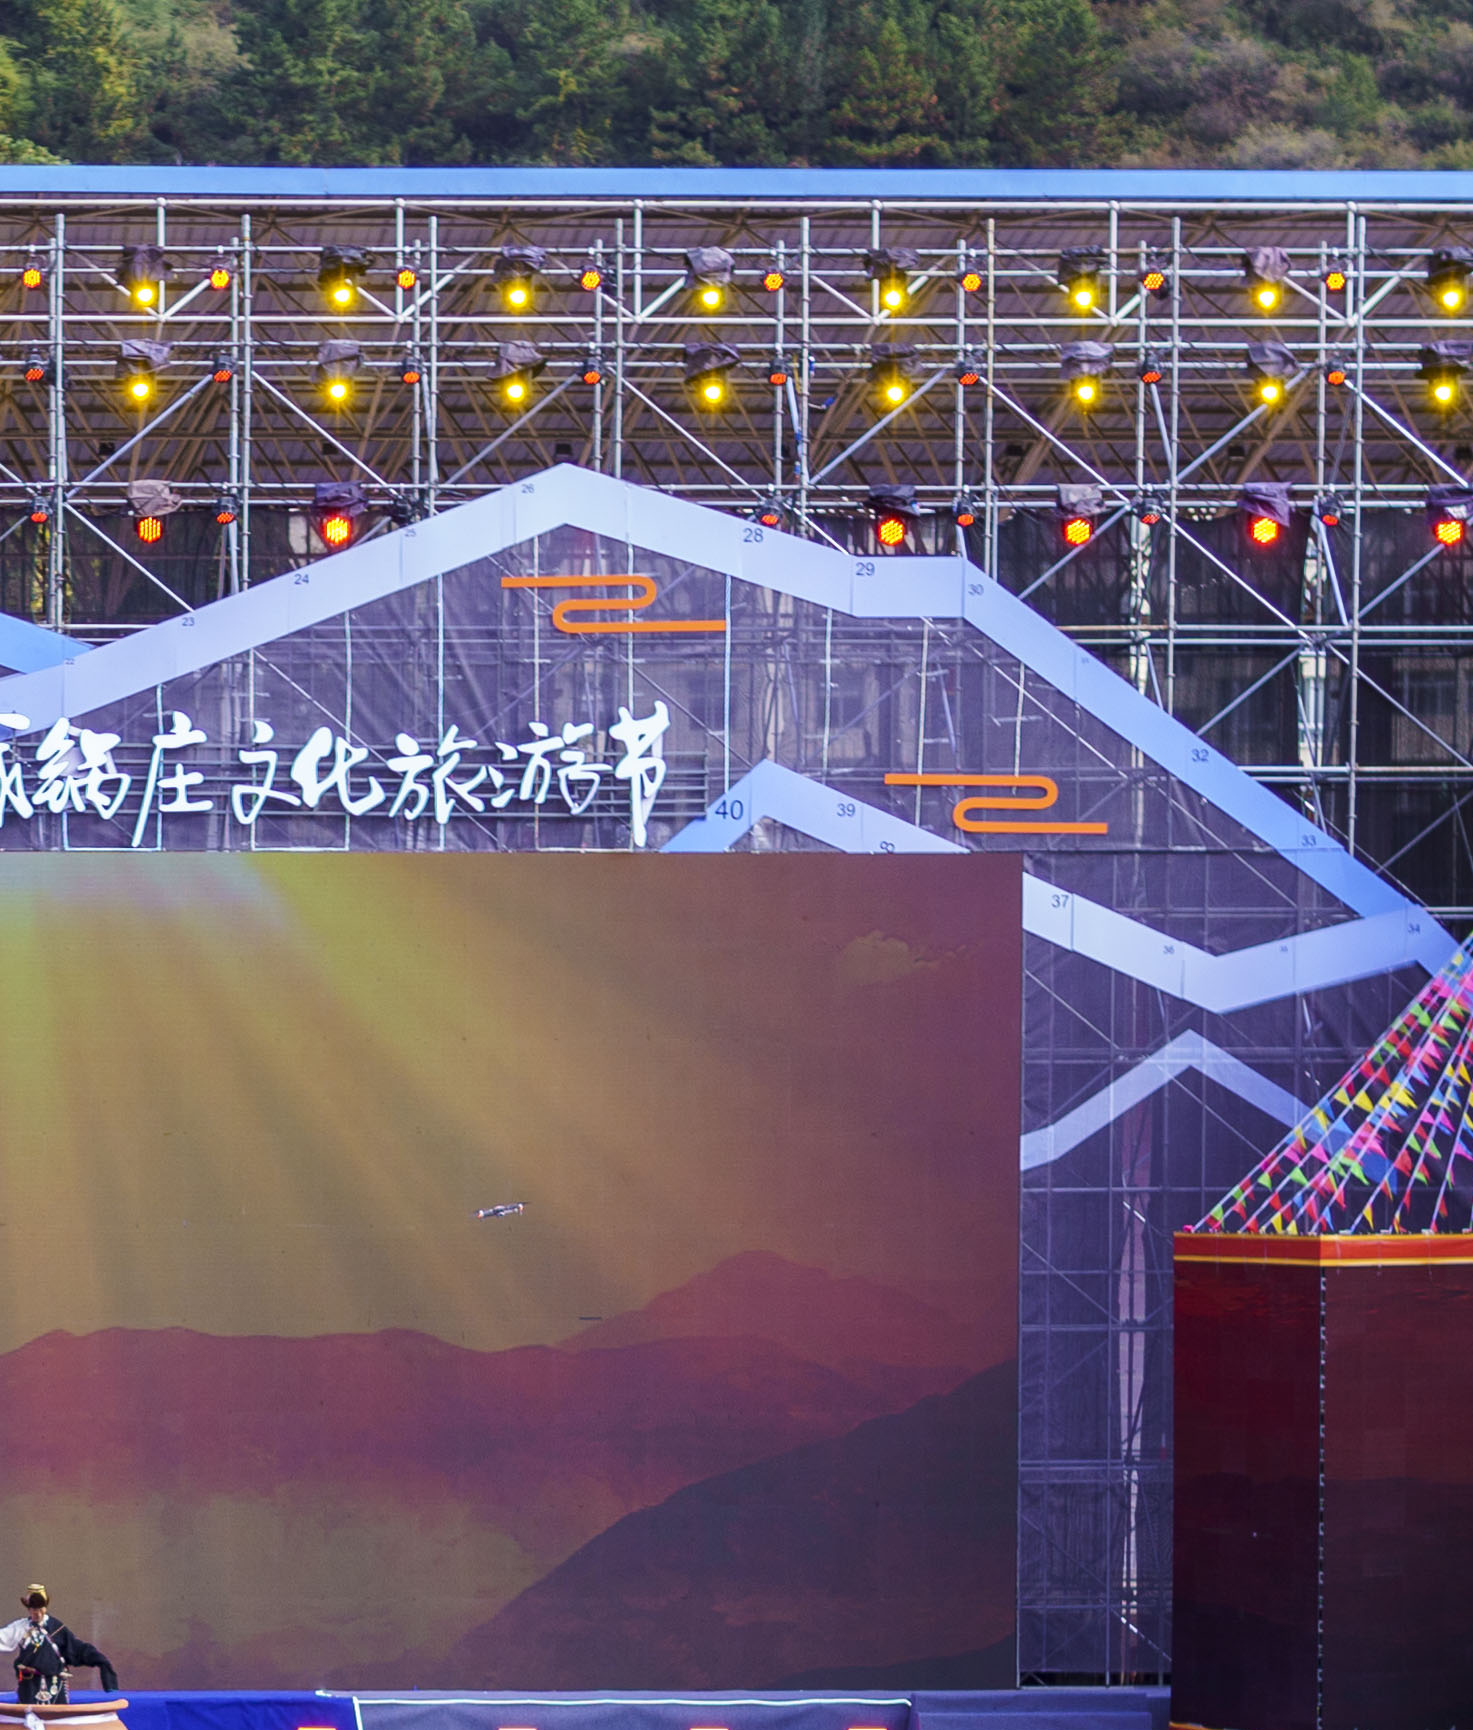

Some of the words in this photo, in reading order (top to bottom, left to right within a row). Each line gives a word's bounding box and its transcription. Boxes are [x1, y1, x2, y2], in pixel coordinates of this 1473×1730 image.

[521, 483, 534, 494] 26
[404, 528, 417, 538] 25
[743, 528, 764, 543] 28
[855, 562, 876, 577] 29
[294, 573, 309, 584] 24
[967, 583, 984, 596] 30
[182, 617, 195, 626] 23
[1191, 748, 1209, 762] 32
[715, 799, 744, 820] 40
[836, 803, 856, 818] 39
[1301, 834, 1316, 847] 33
[1051, 894, 1069, 908] 37
[1407, 923, 1420, 934] 34
